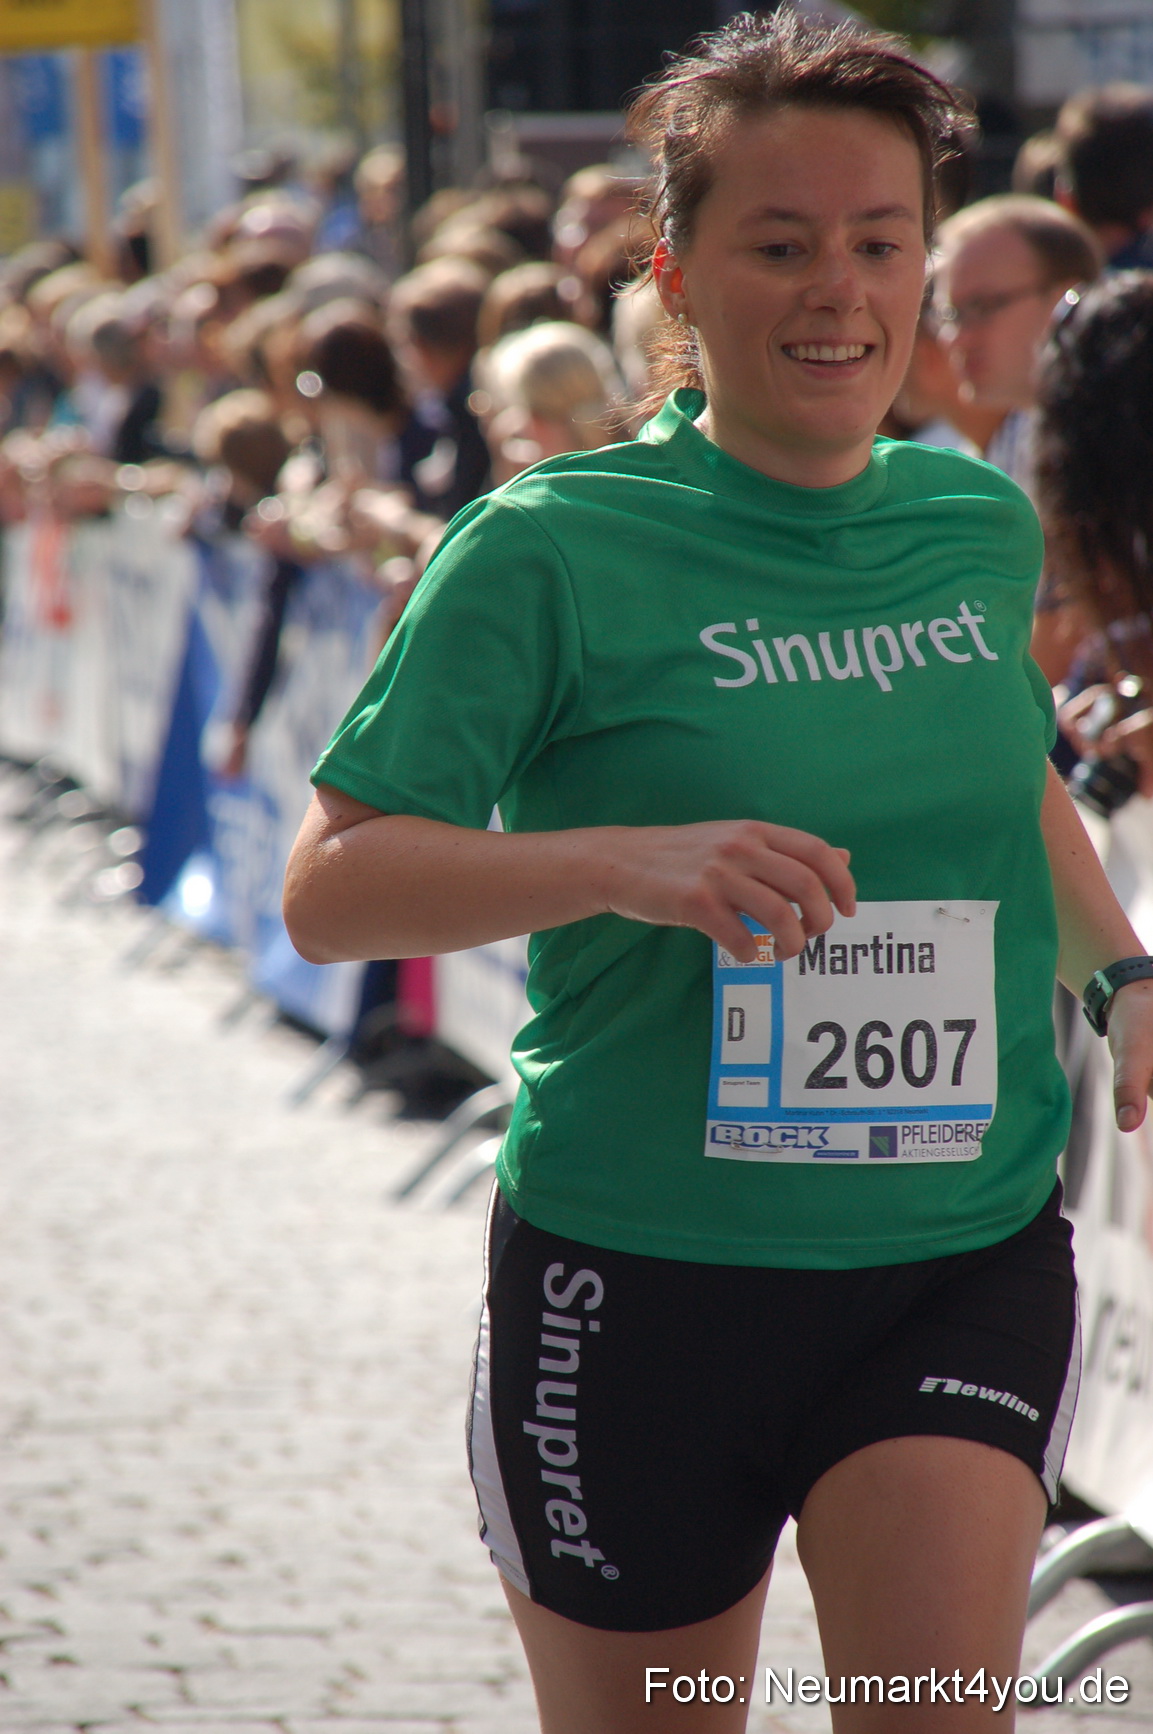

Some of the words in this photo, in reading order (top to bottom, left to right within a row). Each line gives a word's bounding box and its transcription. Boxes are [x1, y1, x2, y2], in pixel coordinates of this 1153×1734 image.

[798, 932, 936, 976] Martina
[727, 1007, 746, 1042] D
[804, 1019, 977, 1089] 2607
[710, 1124, 830, 1149] BOCK
[901, 1123, 989, 1145] PFLEIDERE
